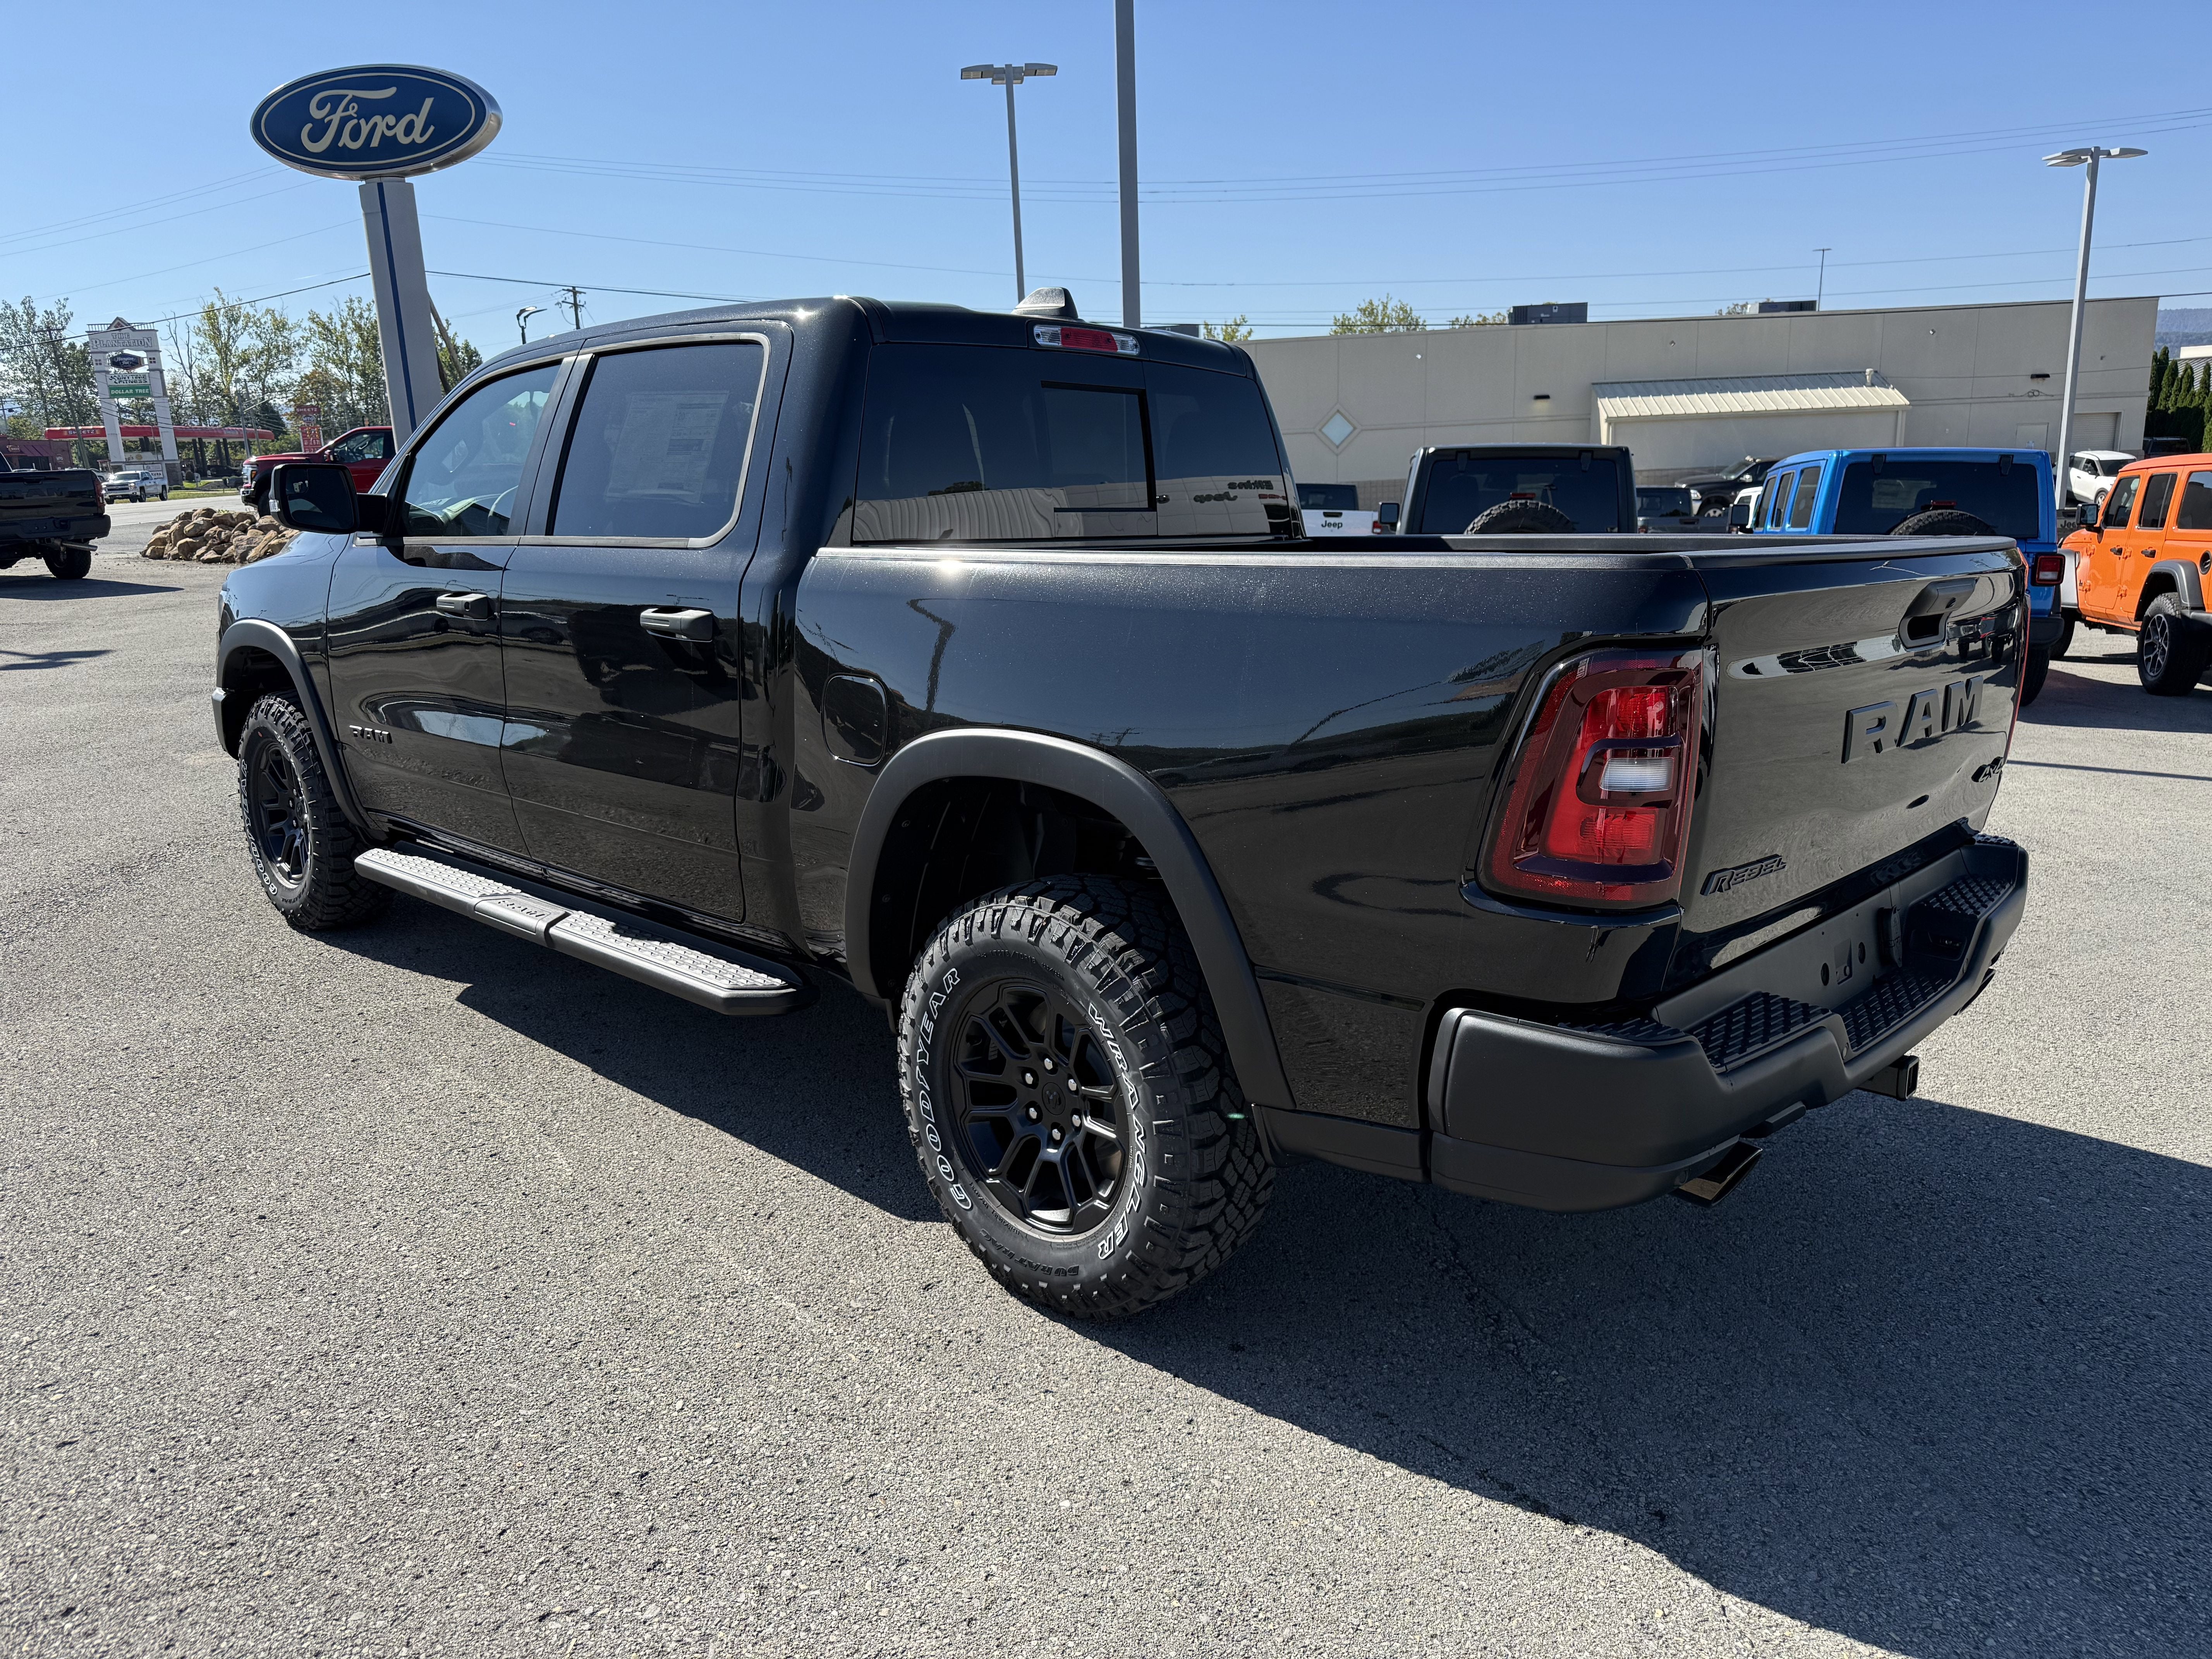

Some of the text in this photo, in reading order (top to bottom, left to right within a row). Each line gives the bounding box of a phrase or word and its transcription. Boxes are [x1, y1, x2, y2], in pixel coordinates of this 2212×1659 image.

[301, 86, 434, 153] Ford
[91, 337, 153, 349] PLANTATION
[1321, 520, 1343, 529] Jeep
[2060, 520, 2077, 528] Jee
[349, 725, 392, 744] RAM
[1841, 675, 1983, 764] RAM
[1700, 854, 1787, 896] REBEL
[916, 968, 972, 1210] GOODYEAR
[1089, 1002, 1146, 1260] WRANGLER
